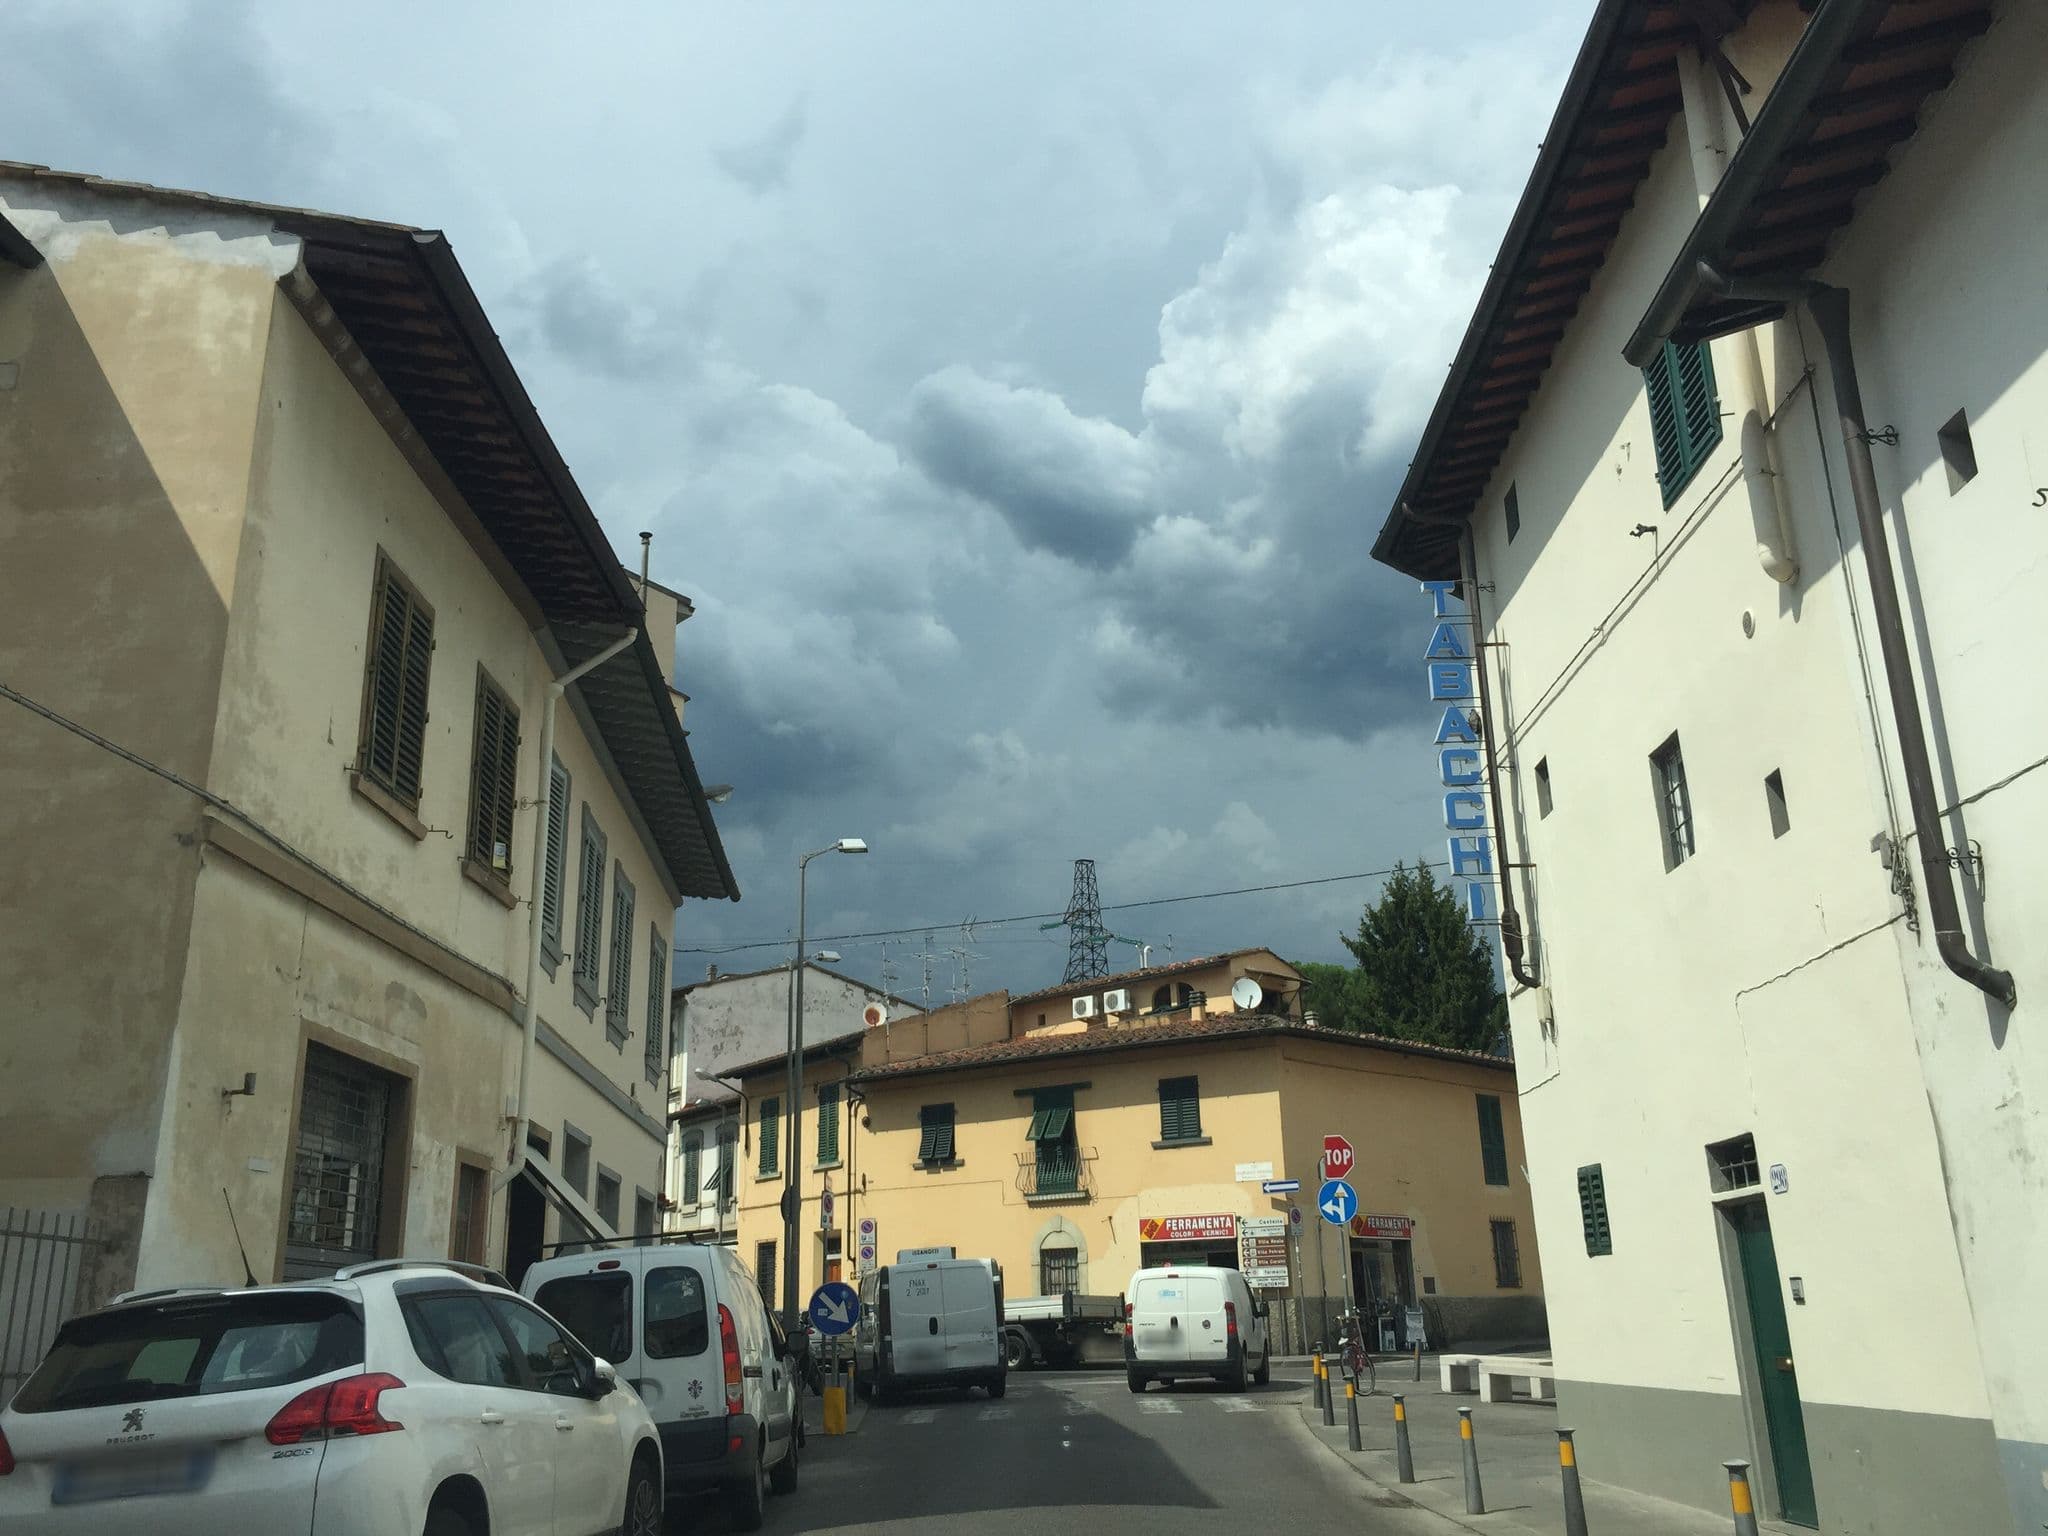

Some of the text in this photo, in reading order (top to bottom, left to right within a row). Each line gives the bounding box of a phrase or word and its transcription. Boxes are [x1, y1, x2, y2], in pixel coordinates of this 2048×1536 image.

[1420, 581, 1492, 921] TABACCHI
[1166, 1216, 1232, 1231] FERRAMENTA
[1368, 1217, 1410, 1229] FERRAMENTA
[106, 1433, 156, 1444] PEUGEOT
